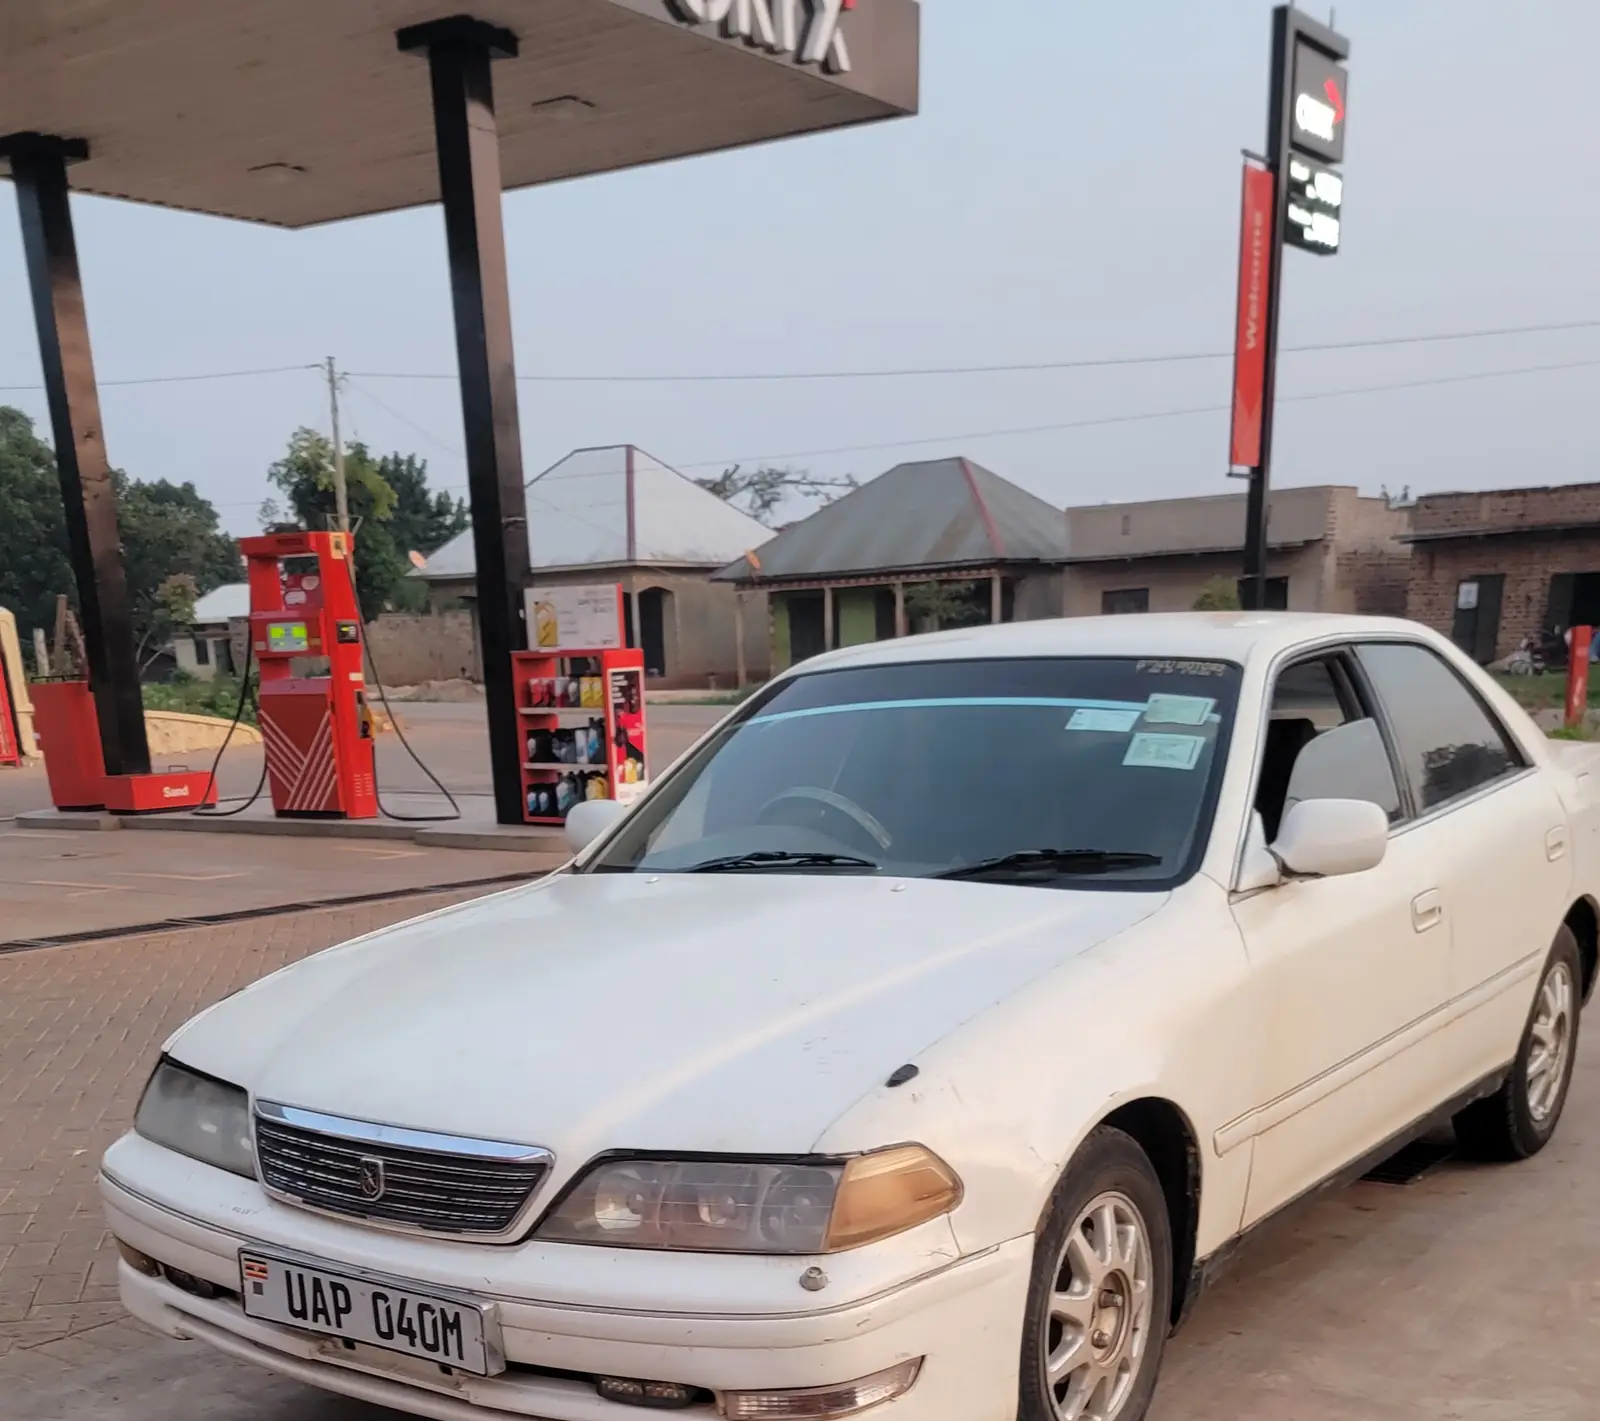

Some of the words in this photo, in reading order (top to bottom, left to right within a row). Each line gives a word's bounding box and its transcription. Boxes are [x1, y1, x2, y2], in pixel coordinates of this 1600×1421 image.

[163, 784, 189, 798] Sand
[285, 1269, 352, 1329] UAP
[372, 1291, 464, 1361] 040M
